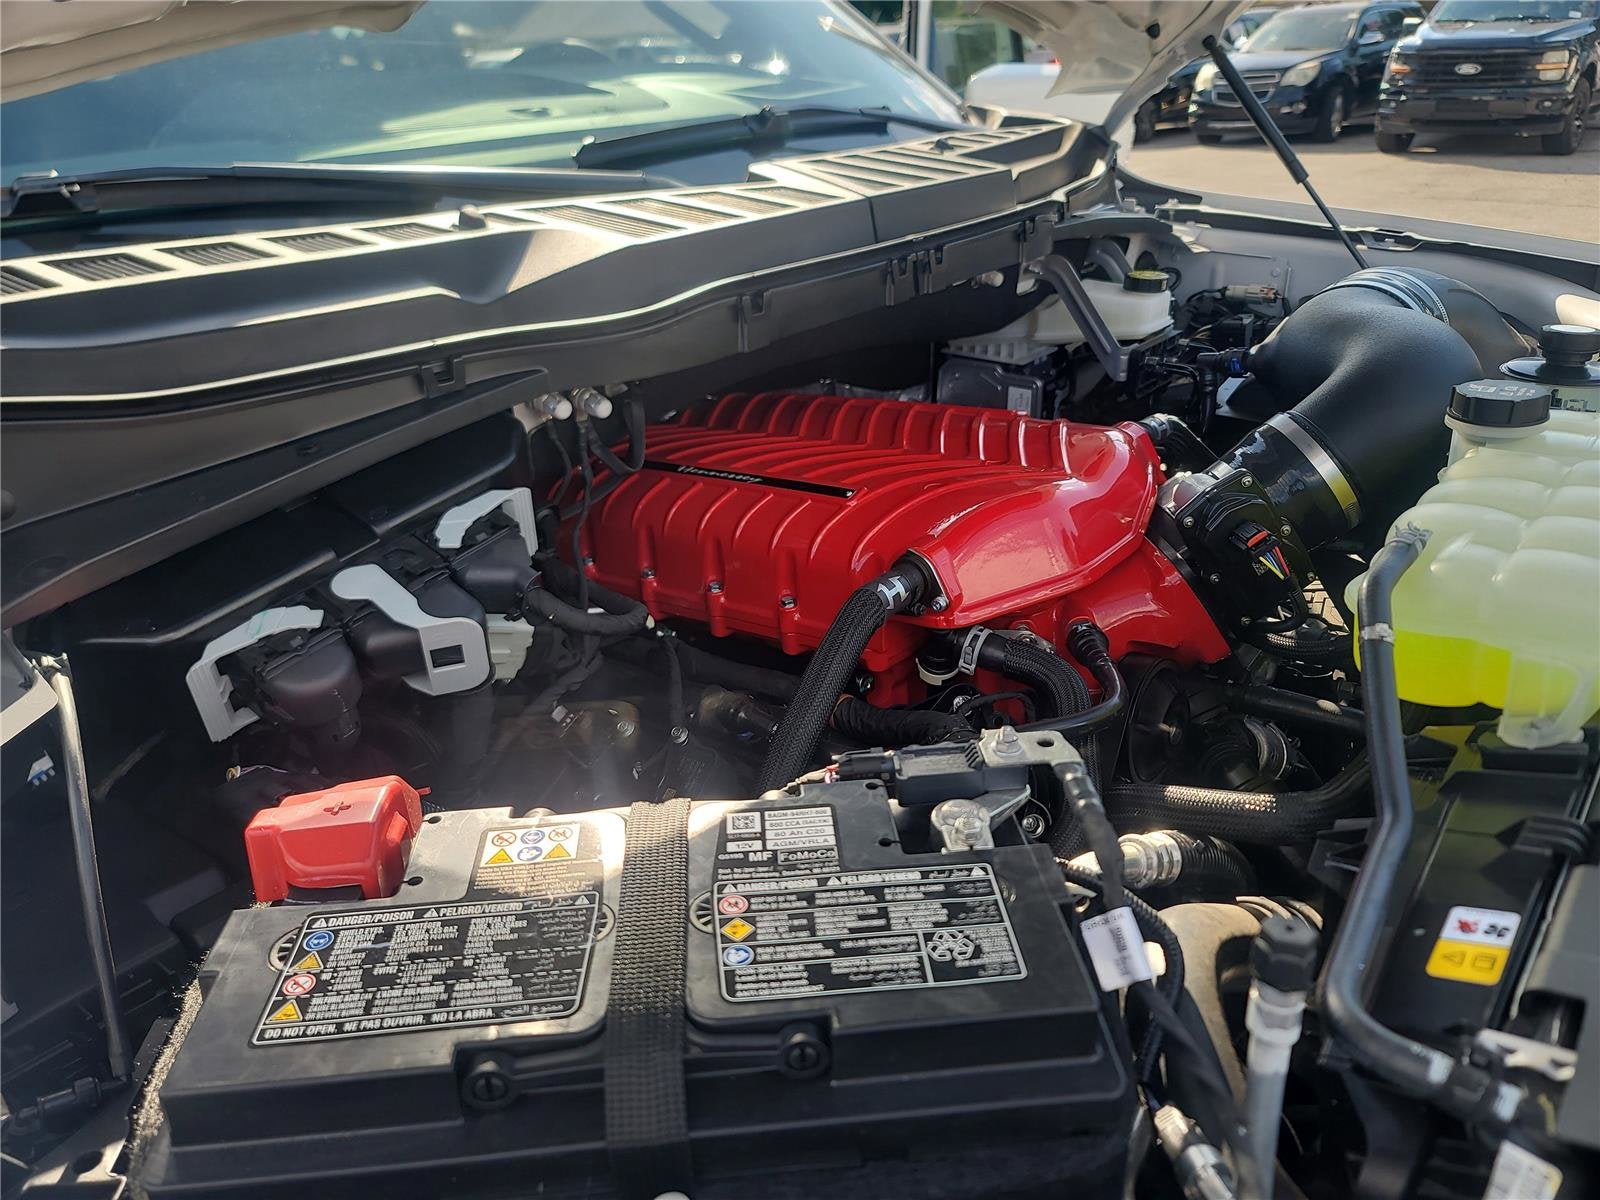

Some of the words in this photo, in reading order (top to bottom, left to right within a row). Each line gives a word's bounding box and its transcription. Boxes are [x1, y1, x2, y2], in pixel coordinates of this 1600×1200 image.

[772, 838, 830, 848] AGM/VRLA
[748, 852, 774, 862] MF
[780, 850, 836, 861] FoMoCo
[440, 902, 523, 917] PELIGRO/VENENO
[328, 911, 414, 927] DANGER/POISON
[264, 1028, 279, 1040] DO
[283, 1026, 304, 1039] NOT
[305, 1024, 338, 1036] OPEN.
[343, 1021, 358, 1032] NE
[359, 1018, 382, 1030] PAS
[382, 1014, 426, 1028] OUVRIR.
[431, 1012, 448, 1022] NO
[450, 1011, 463, 1022] LA
[463, 1008, 495, 1020] ABRA.
